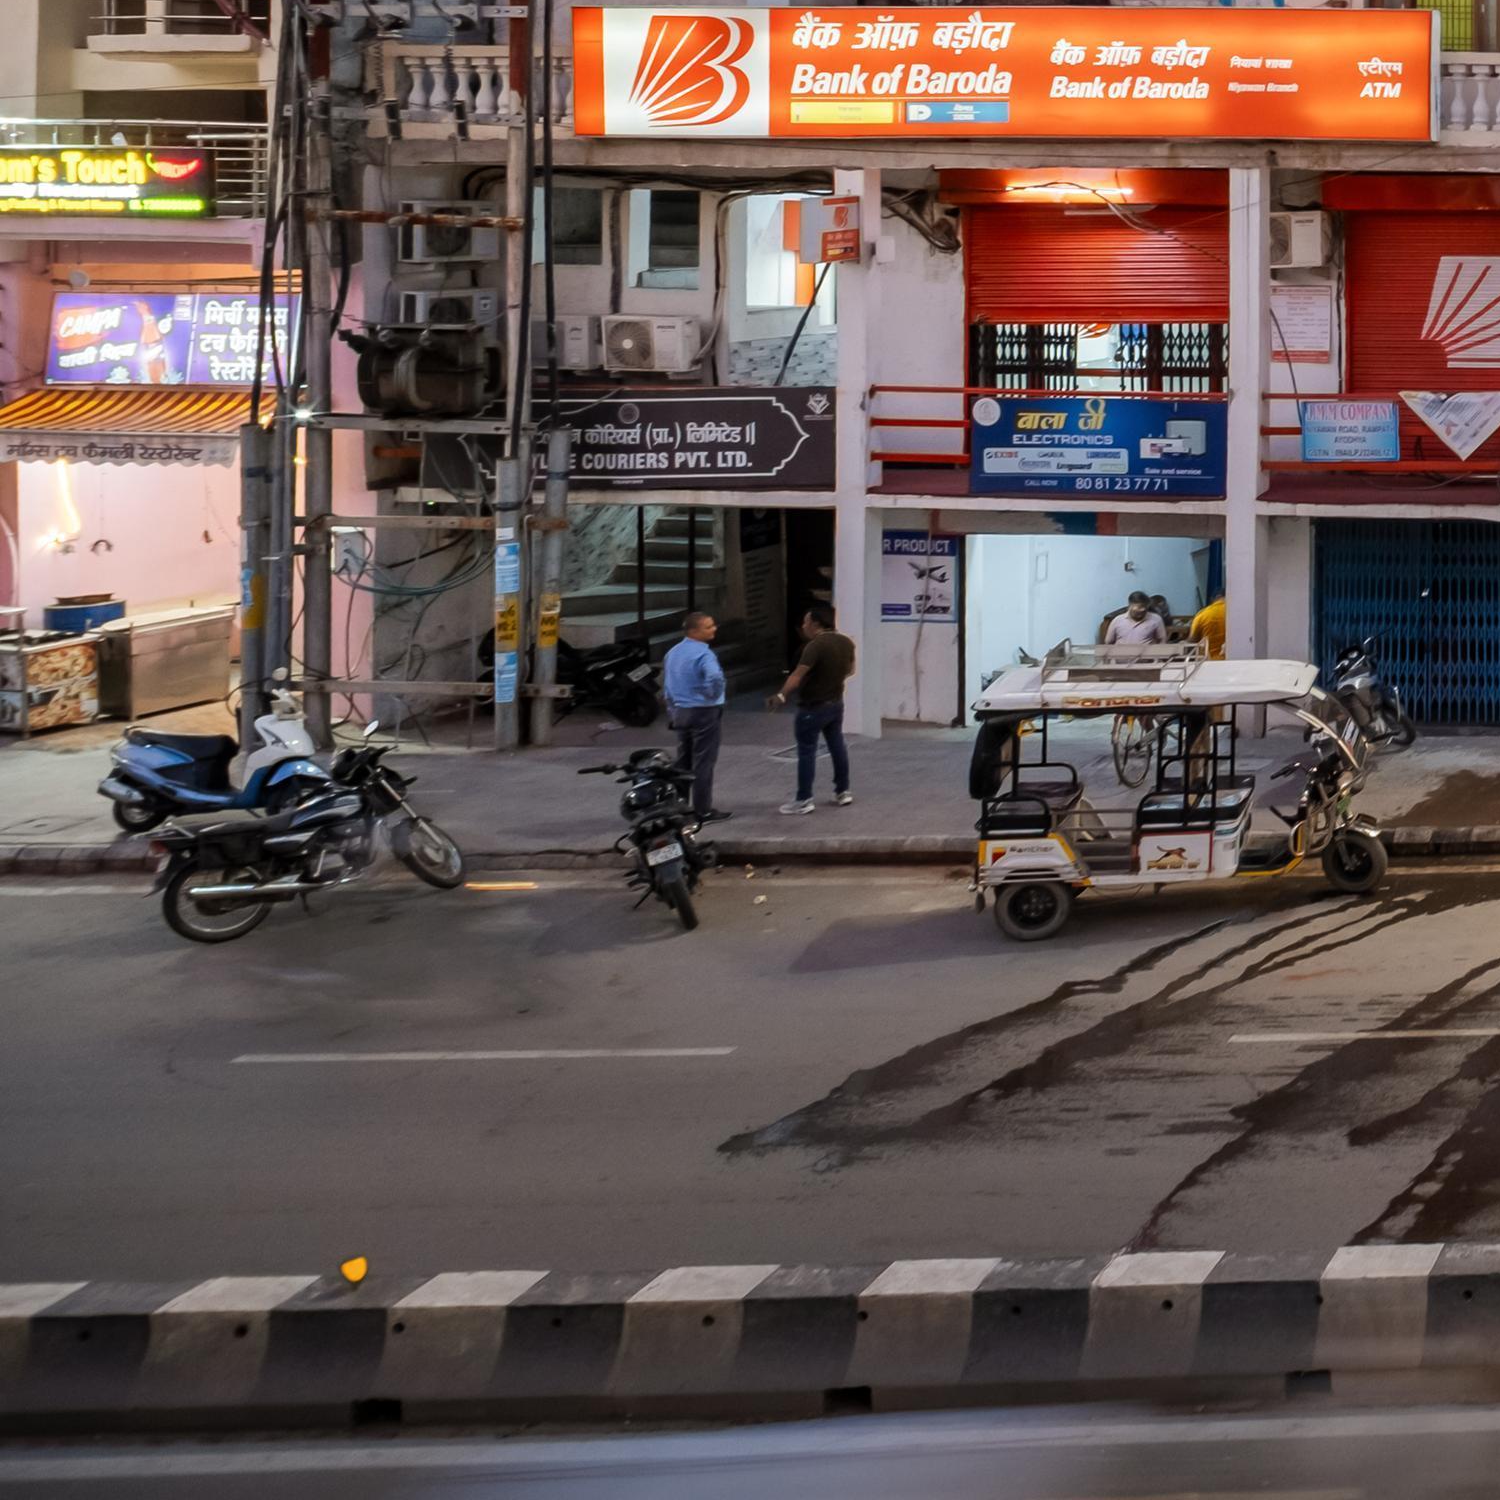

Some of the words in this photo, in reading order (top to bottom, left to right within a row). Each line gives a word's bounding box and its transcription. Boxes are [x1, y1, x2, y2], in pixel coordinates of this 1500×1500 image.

[791, 11, 843, 49] बैंक
[932, 11, 1016, 55] बड़ौदा
[1050, 39, 1087, 66] बैंक
[1151, 39, 1211, 70] बड़ौदा
[1357, 57, 1403, 76] एटीएम
[790, 63, 869, 95] Bank
[872, 63, 905, 95] of
[905, 63, 1012, 95] Baroda
[1050, 76, 1106, 99] Bank
[1108, 76, 1132, 99] of
[1133, 76, 1209, 100] Baroda
[1360, 82, 1402, 99] ATM
[60, 151, 147, 185] Touch
[204, 300, 247, 326] मिर्ची
[199, 333, 228, 353] टच
[1016, 411, 1068, 431] बाला
[1077, 397, 1107, 432] जी
[686, 421, 741, 444] लिमिटेड
[1012, 434, 1113, 445] ELECTRONICS
[582, 451, 668, 470] COURIERS
[674, 451, 711, 468] PVT.
[717, 450, 752, 468] LTD.
[1075, 477, 1093, 491] 80
[1095, 477, 1110, 491] 81
[1114, 478, 1130, 491] 23
[1134, 478, 1150, 492] 77
[1153, 478, 1168, 492] 71
